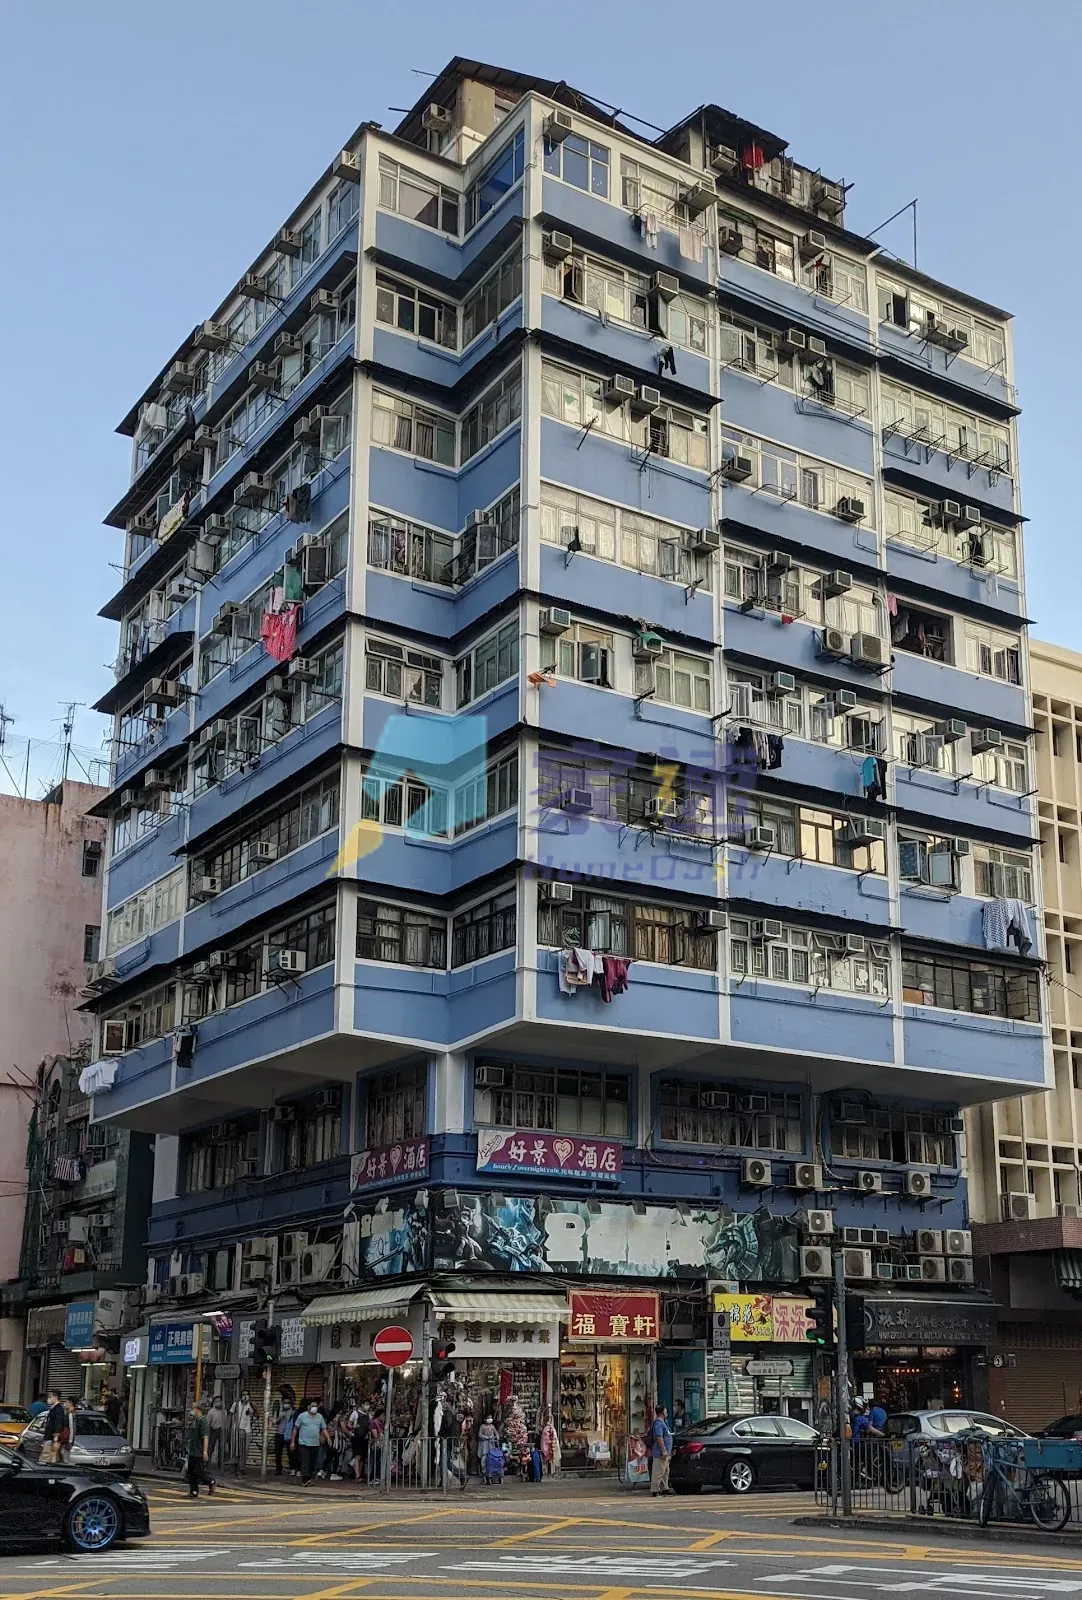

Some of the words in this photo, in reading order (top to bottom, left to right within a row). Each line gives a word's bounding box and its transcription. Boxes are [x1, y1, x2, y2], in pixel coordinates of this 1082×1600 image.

[403, 1144, 426, 1170] 酒店
[508, 1140, 547, 1165] 好景
[578, 1144, 616, 1171] 酒店
[572, 1313, 655, 1337] 福寶軒
[776, 1304, 816, 1340] 深深
[236, 1552, 440, 1569] BUS
[752, 1565, 1082, 1599] 巴士
